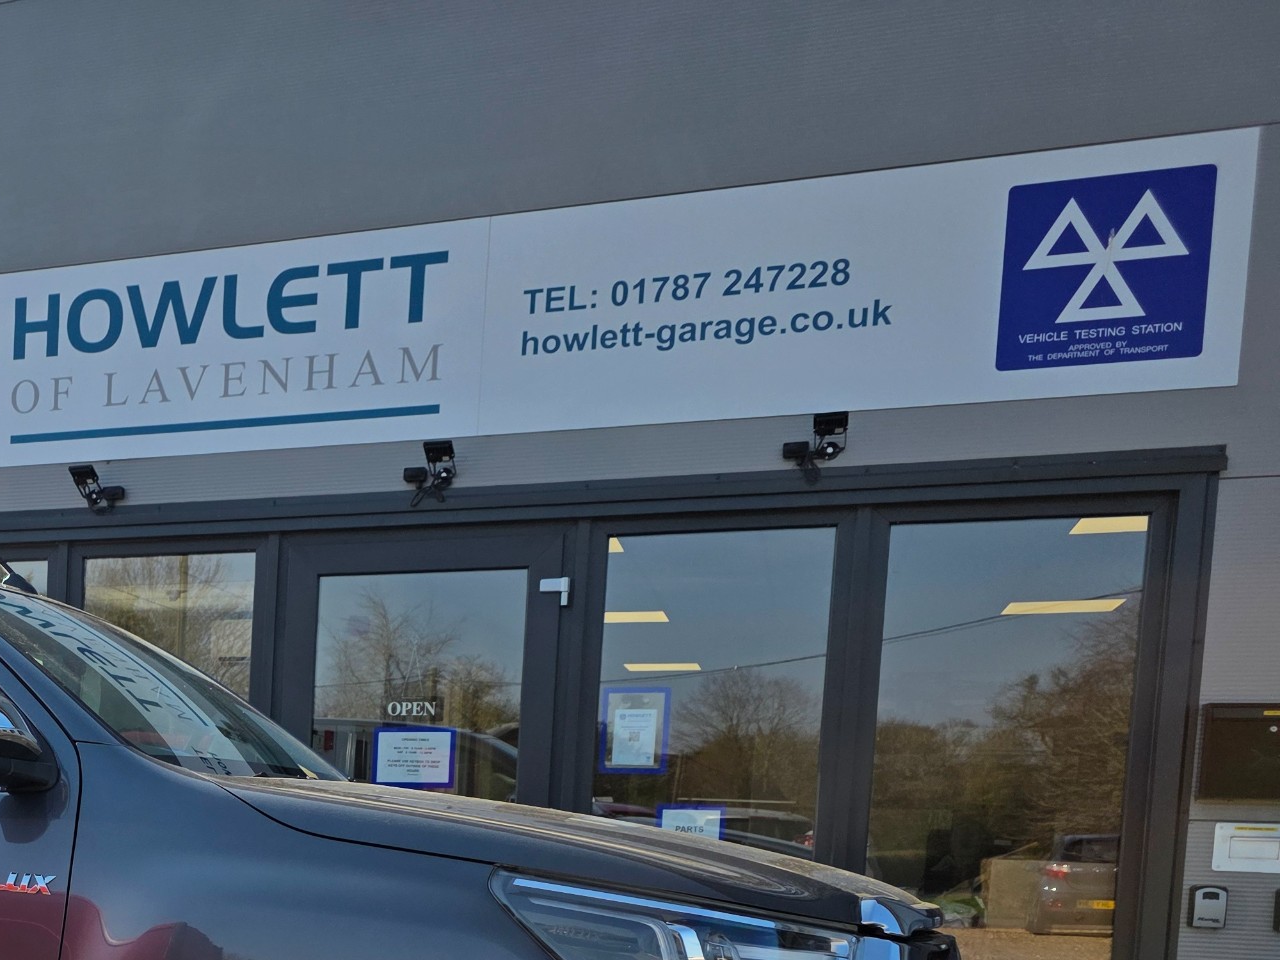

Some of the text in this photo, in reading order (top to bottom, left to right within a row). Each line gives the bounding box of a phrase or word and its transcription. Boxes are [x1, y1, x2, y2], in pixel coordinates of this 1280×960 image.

[523, 258, 852, 315] TEL: 01787 247228
[13, 250, 449, 360] HOWLETT
[520, 299, 893, 357] howlett-garage.co.uk
[1018, 321, 1184, 345] VEHICLE TESTING STATION
[1028, 344, 1169, 362] THE DEPARTMENT OF TRANSPORT
[1067, 340, 1128, 352] APPROVED BY
[11, 343, 445, 415] OF LAVENHAM
[387, 701, 437, 717] OPEN
[675, 825, 705, 834] PARTS
